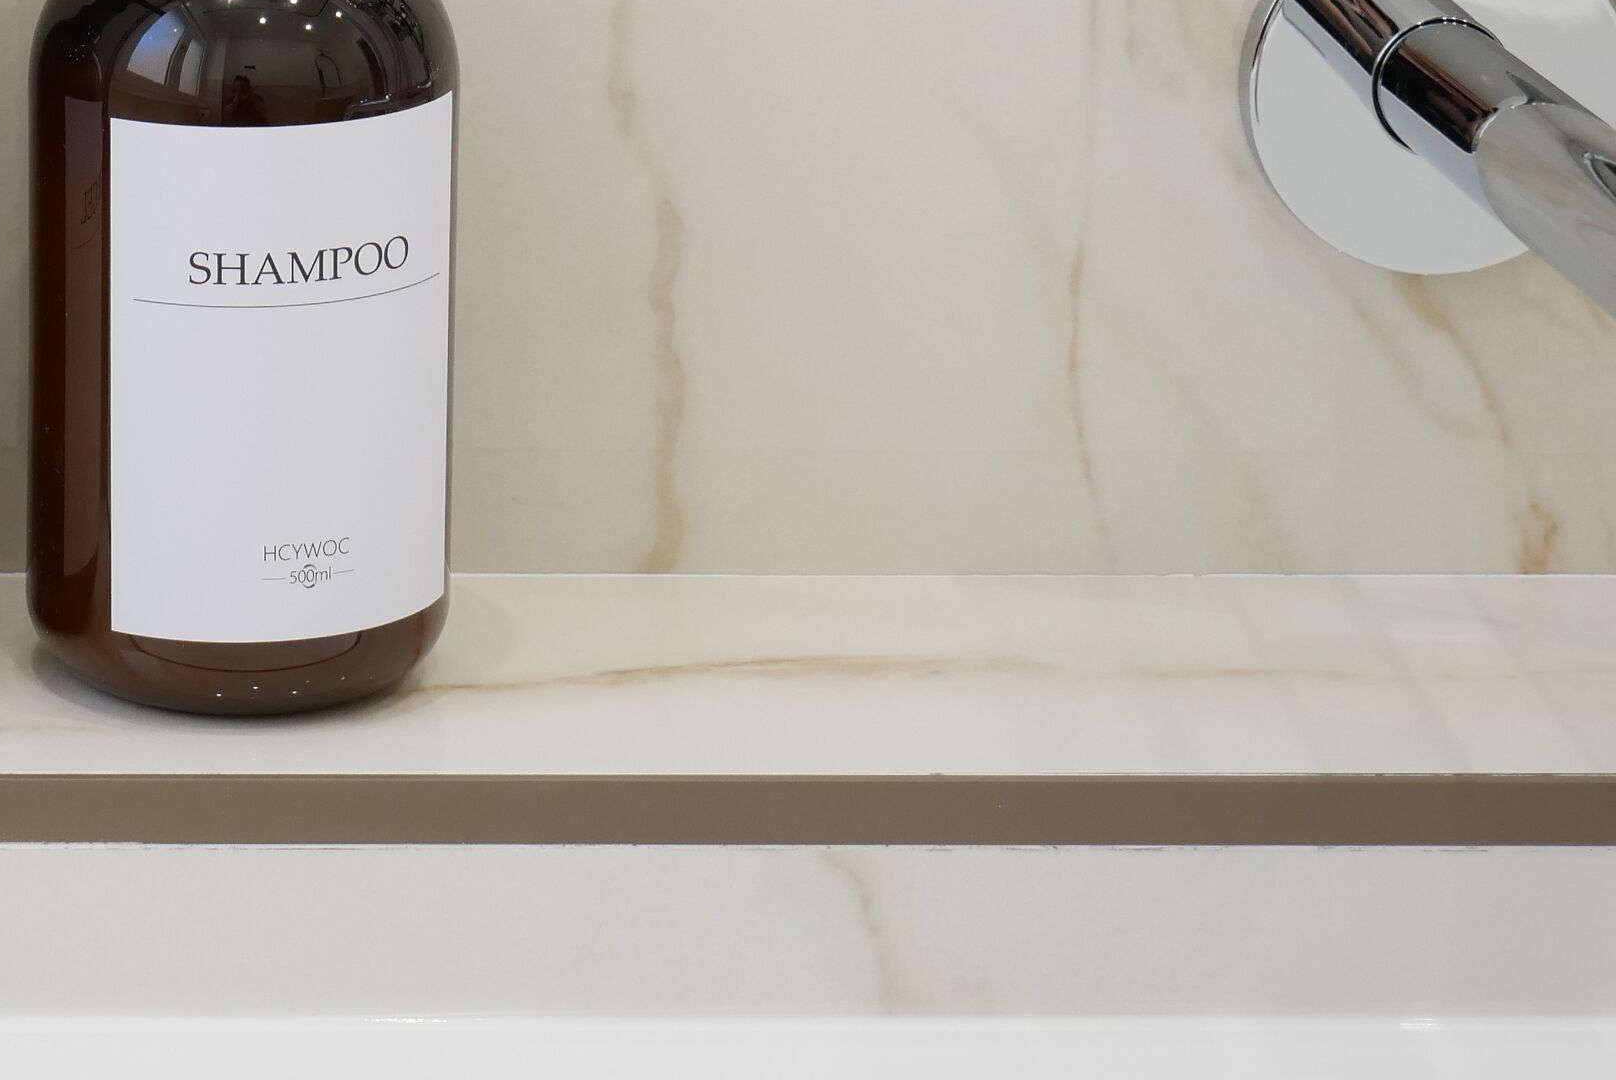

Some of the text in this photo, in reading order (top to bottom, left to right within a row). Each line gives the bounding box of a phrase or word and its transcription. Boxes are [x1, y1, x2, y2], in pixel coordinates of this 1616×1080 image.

[189, 235, 411, 286] SHAMPOO
[263, 536, 350, 563] HCYWOC
[289, 565, 332, 585] 500ml
